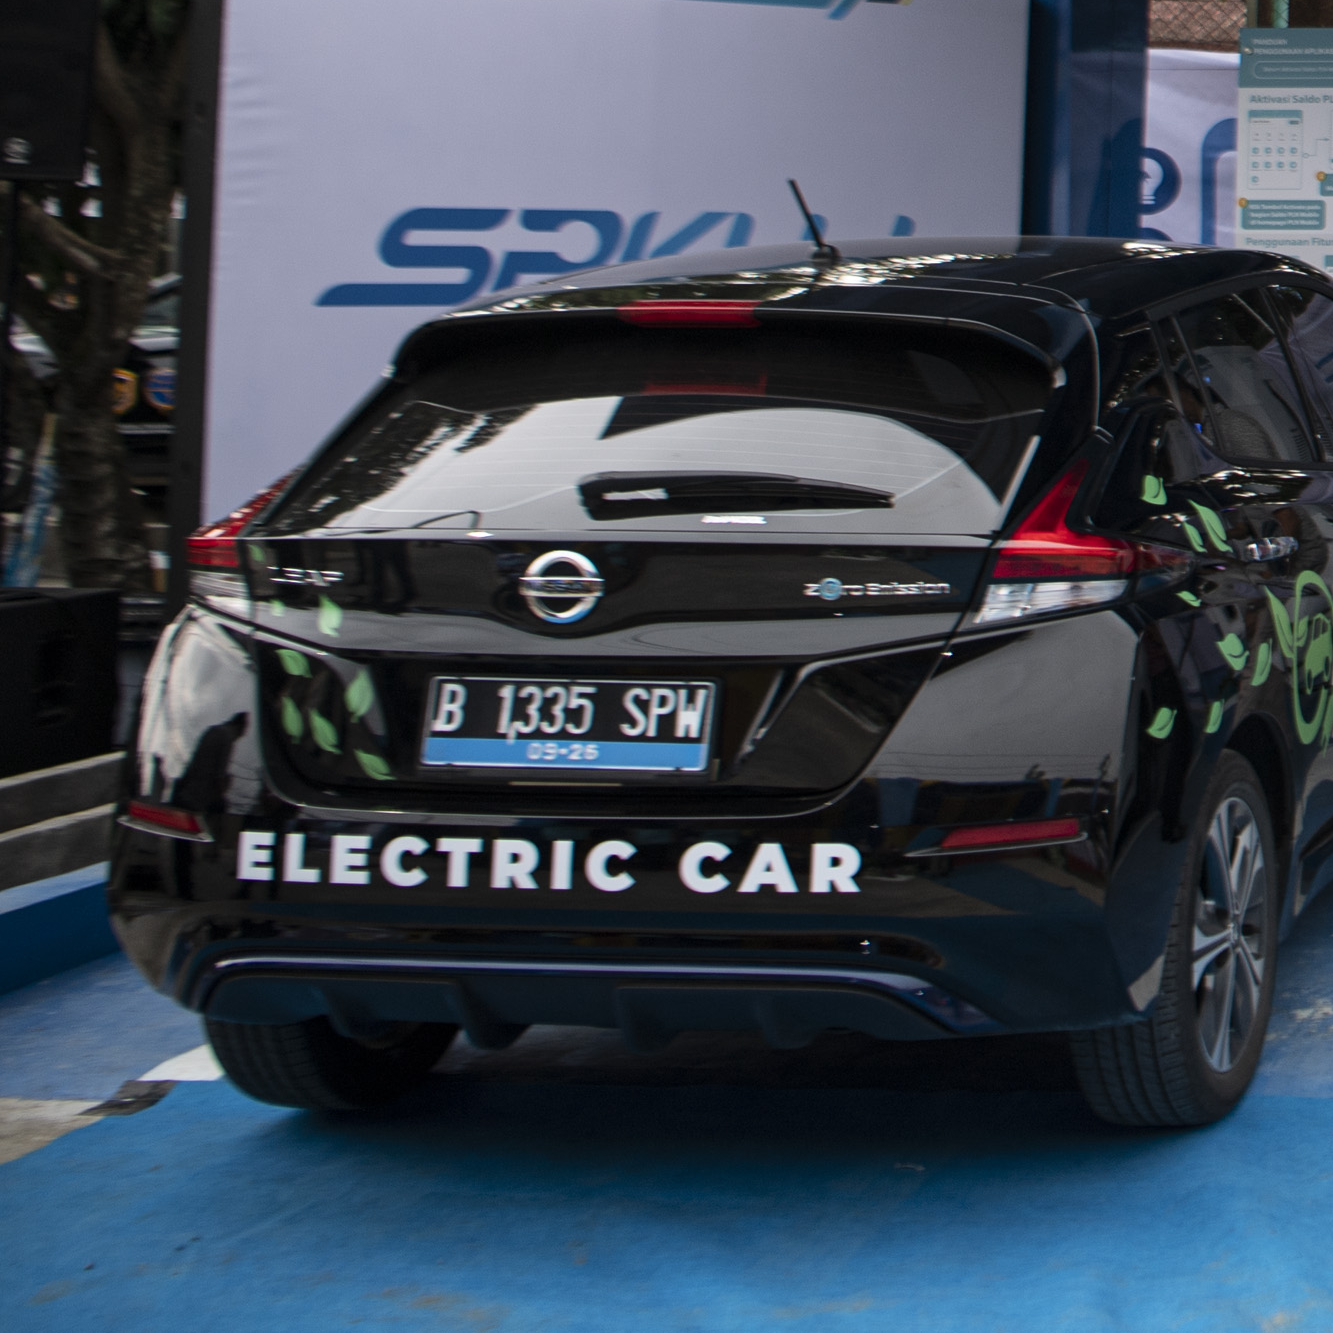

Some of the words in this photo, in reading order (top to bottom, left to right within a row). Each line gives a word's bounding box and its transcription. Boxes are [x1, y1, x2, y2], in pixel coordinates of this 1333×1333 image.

[1249, 95, 1291, 104] Aktivasi
[1292, 95, 1321, 104] Saldo
[1245, 237, 1310, 248] Penggunaan
[430, 682, 468, 733] B
[619, 688, 709, 738] SPW
[236, 830, 638, 892] ELECTRIC
[678, 841, 862, 894] CAR
